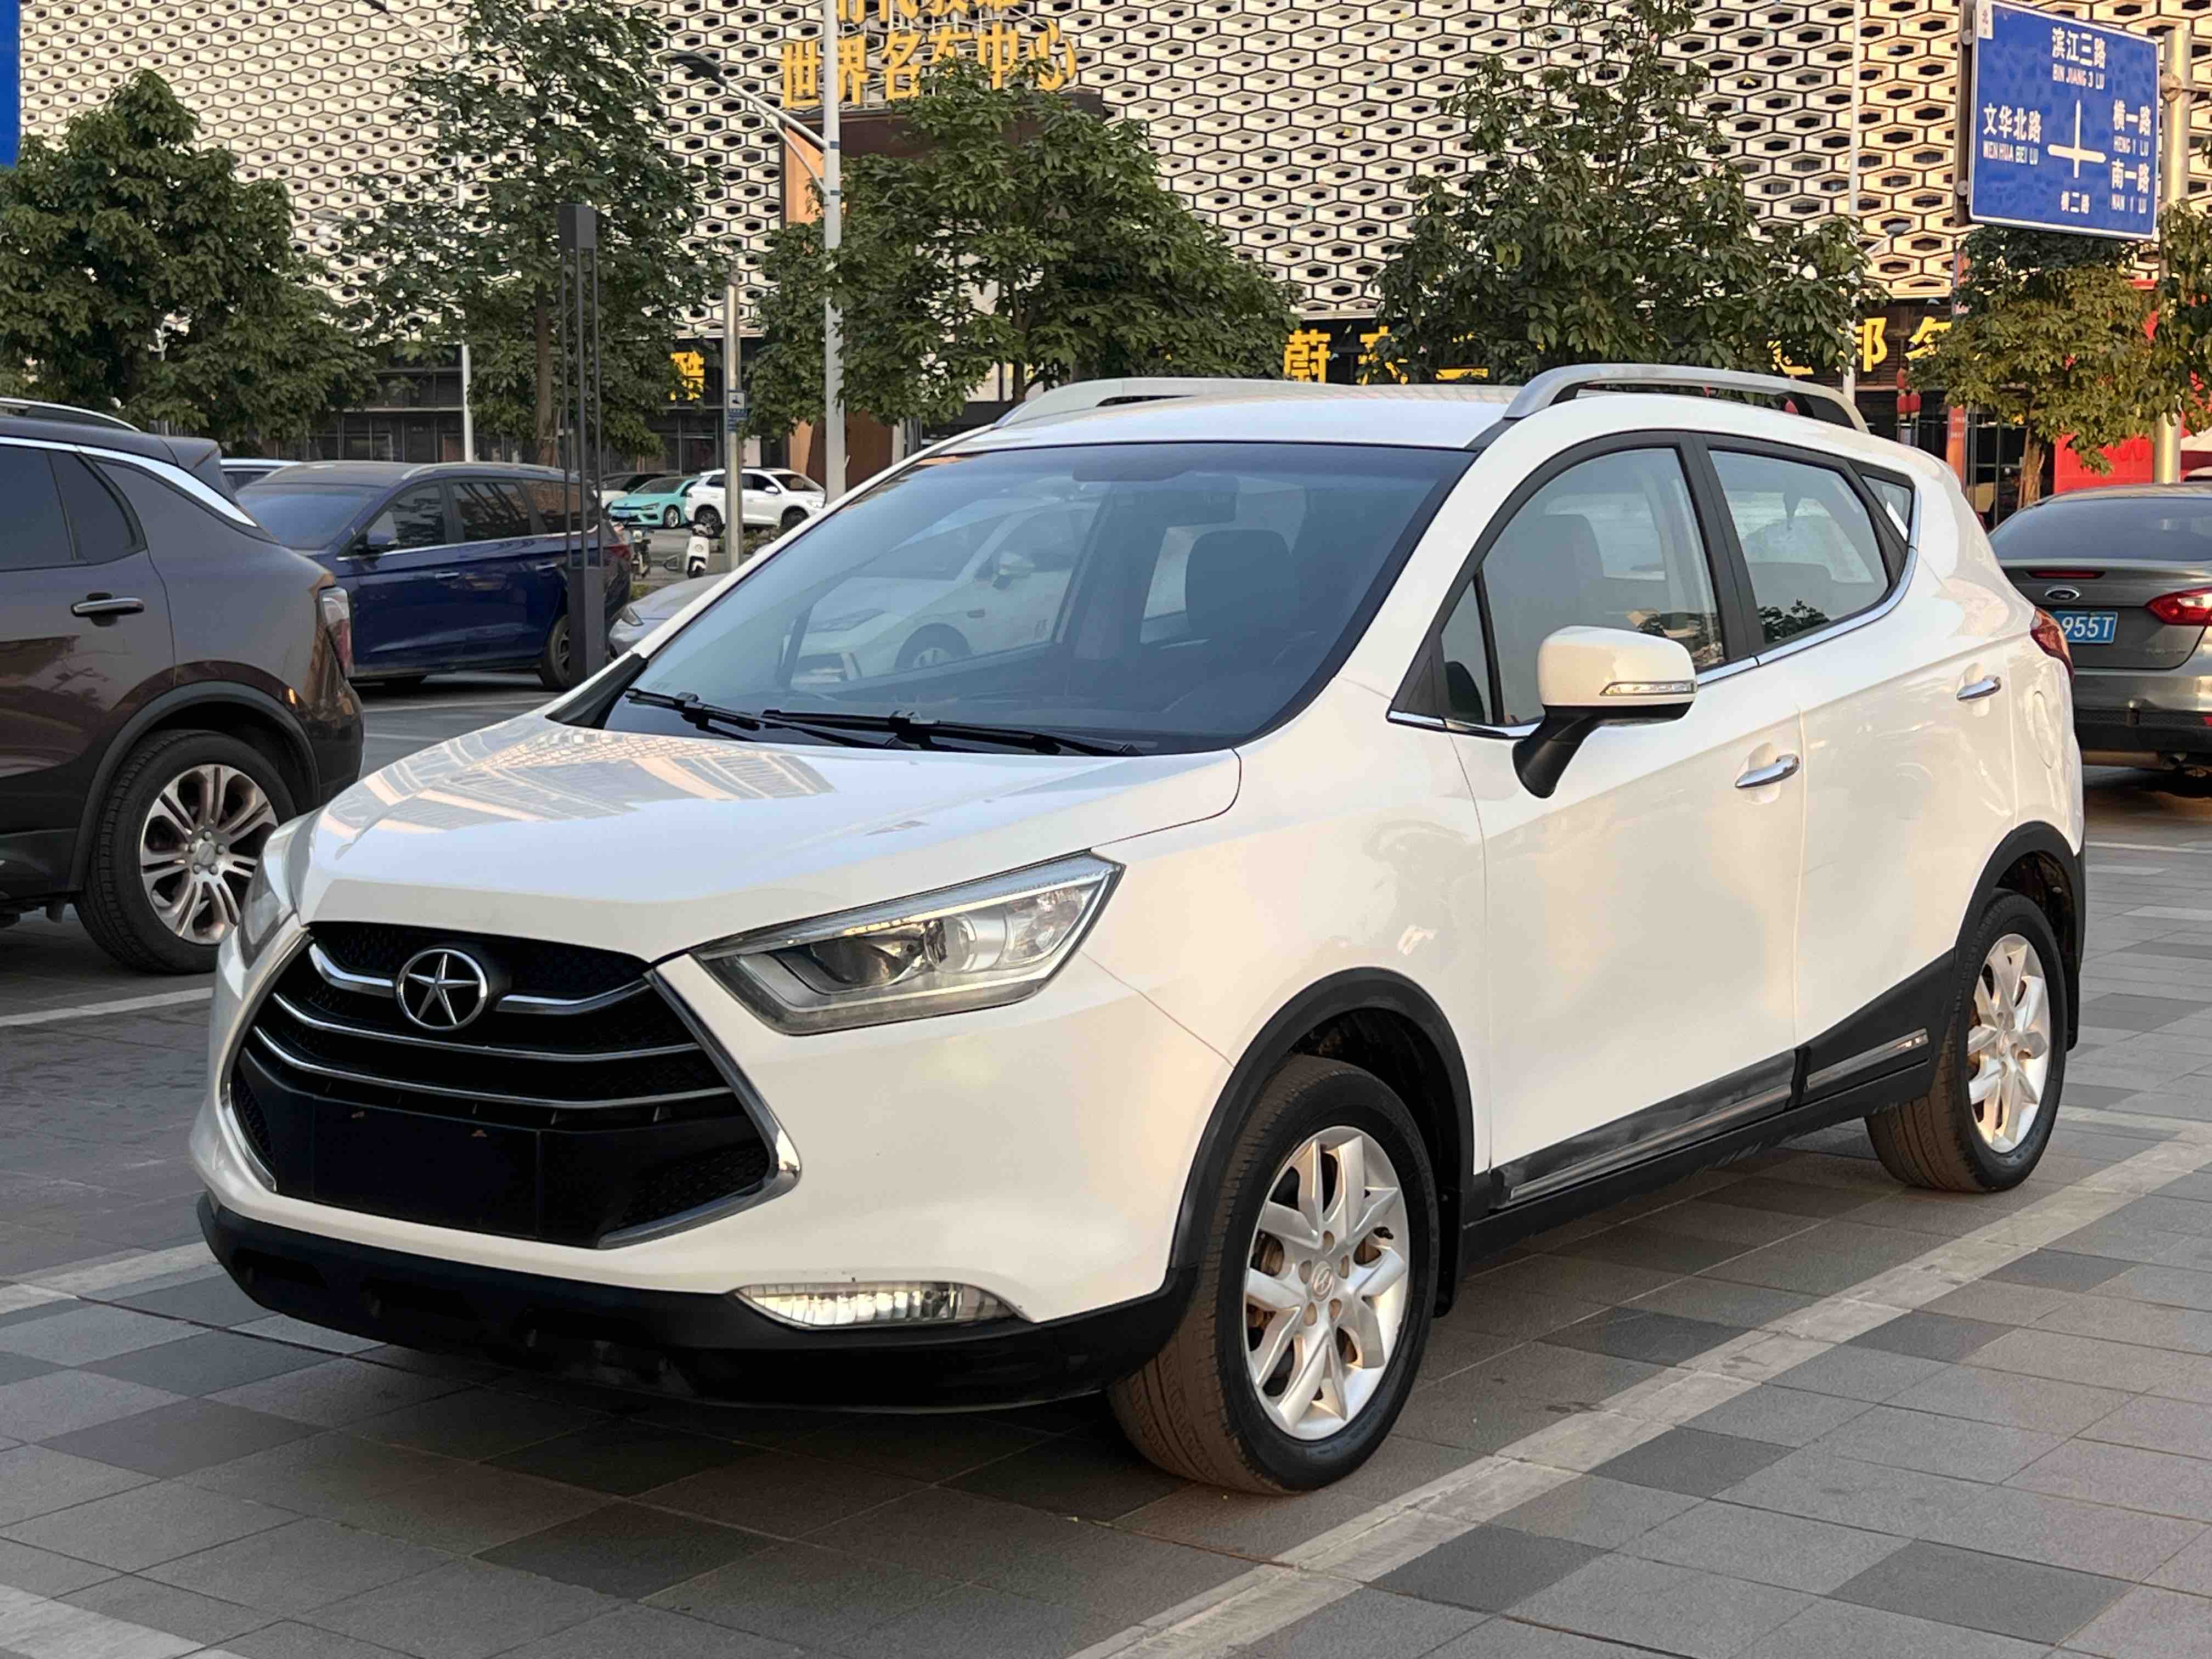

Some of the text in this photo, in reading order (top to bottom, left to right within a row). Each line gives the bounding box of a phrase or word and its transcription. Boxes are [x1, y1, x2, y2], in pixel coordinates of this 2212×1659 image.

[2052, 26, 2106, 69] 滨江三路
[2095, 72, 2105, 90] LU
[1983, 102, 2041, 144] 文华北路
[2029, 147, 2039, 166] LU
[2111, 158, 2150, 194] 南一路
[2062, 616, 2114, 639] 955T
